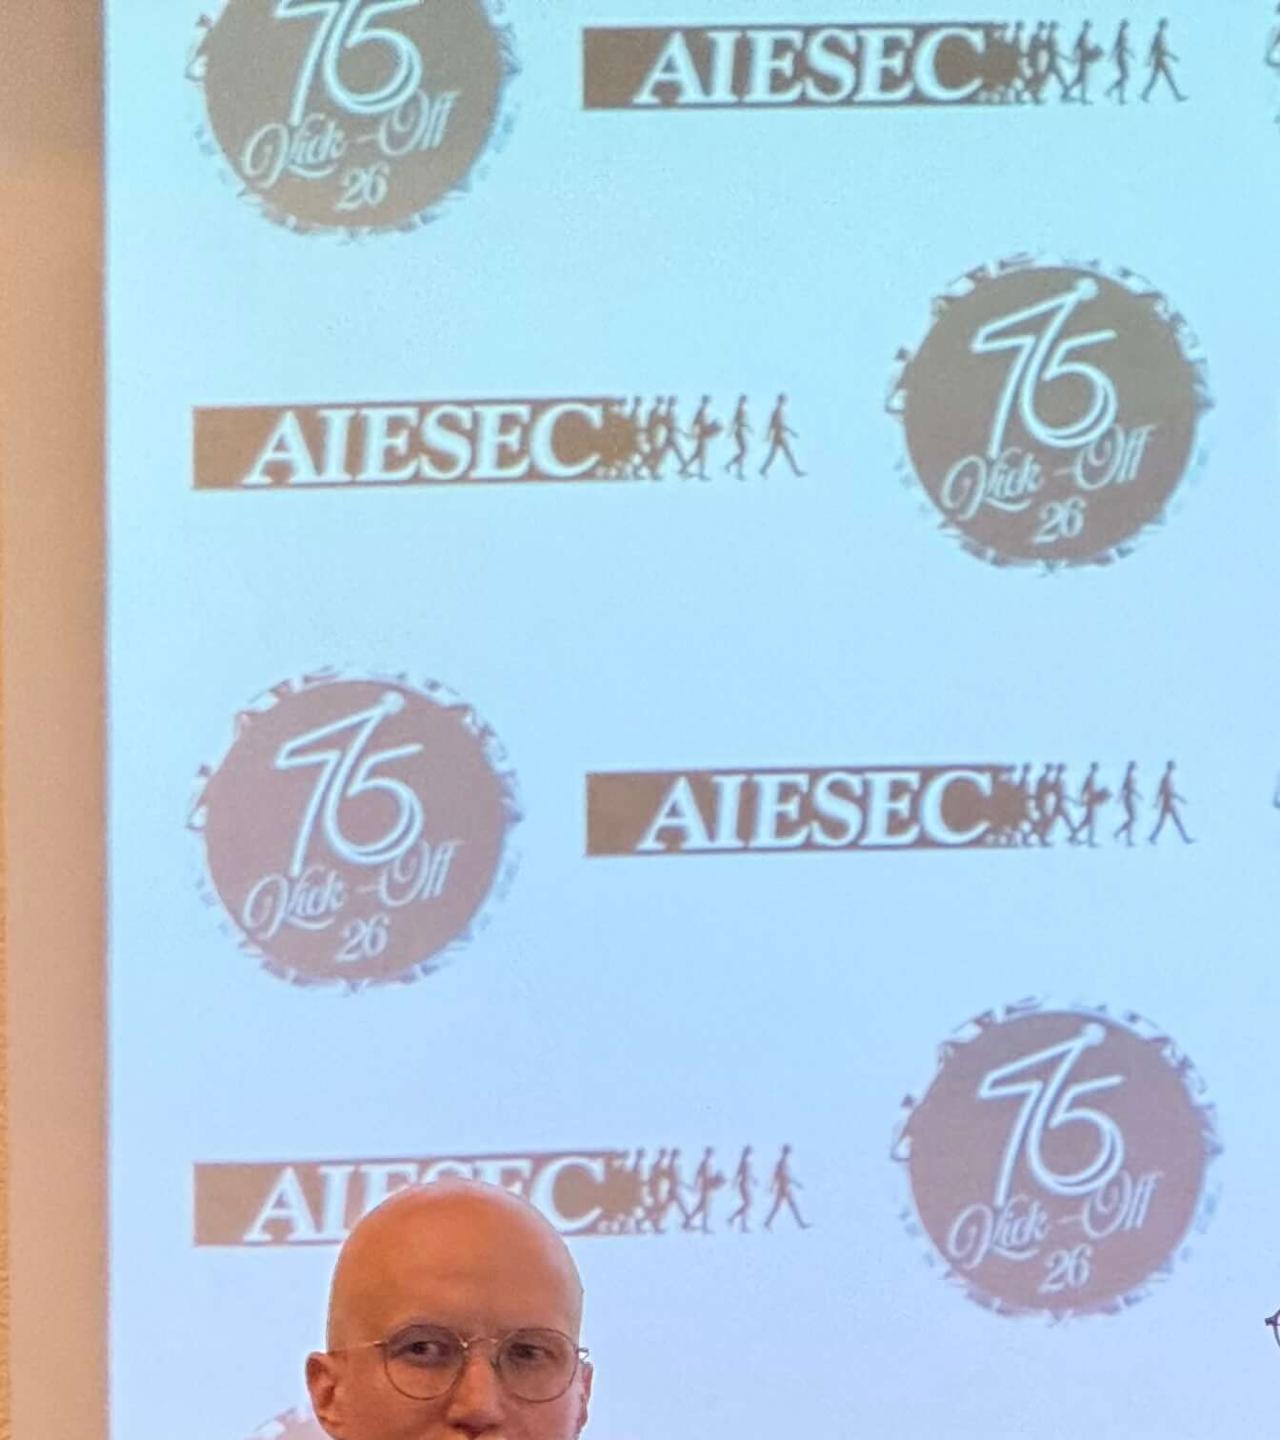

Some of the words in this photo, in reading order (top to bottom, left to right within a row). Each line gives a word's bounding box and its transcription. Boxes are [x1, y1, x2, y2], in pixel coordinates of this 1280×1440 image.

[631, 27, 986, 104] AIESEC
[333, 161, 391, 211] 26
[241, 403, 605, 486] AIESEC
[1033, 496, 1087, 544] 26
[635, 770, 993, 850] AIESEC
[334, 912, 391, 963] 26
[1036, 1242, 1093, 1294] 26
